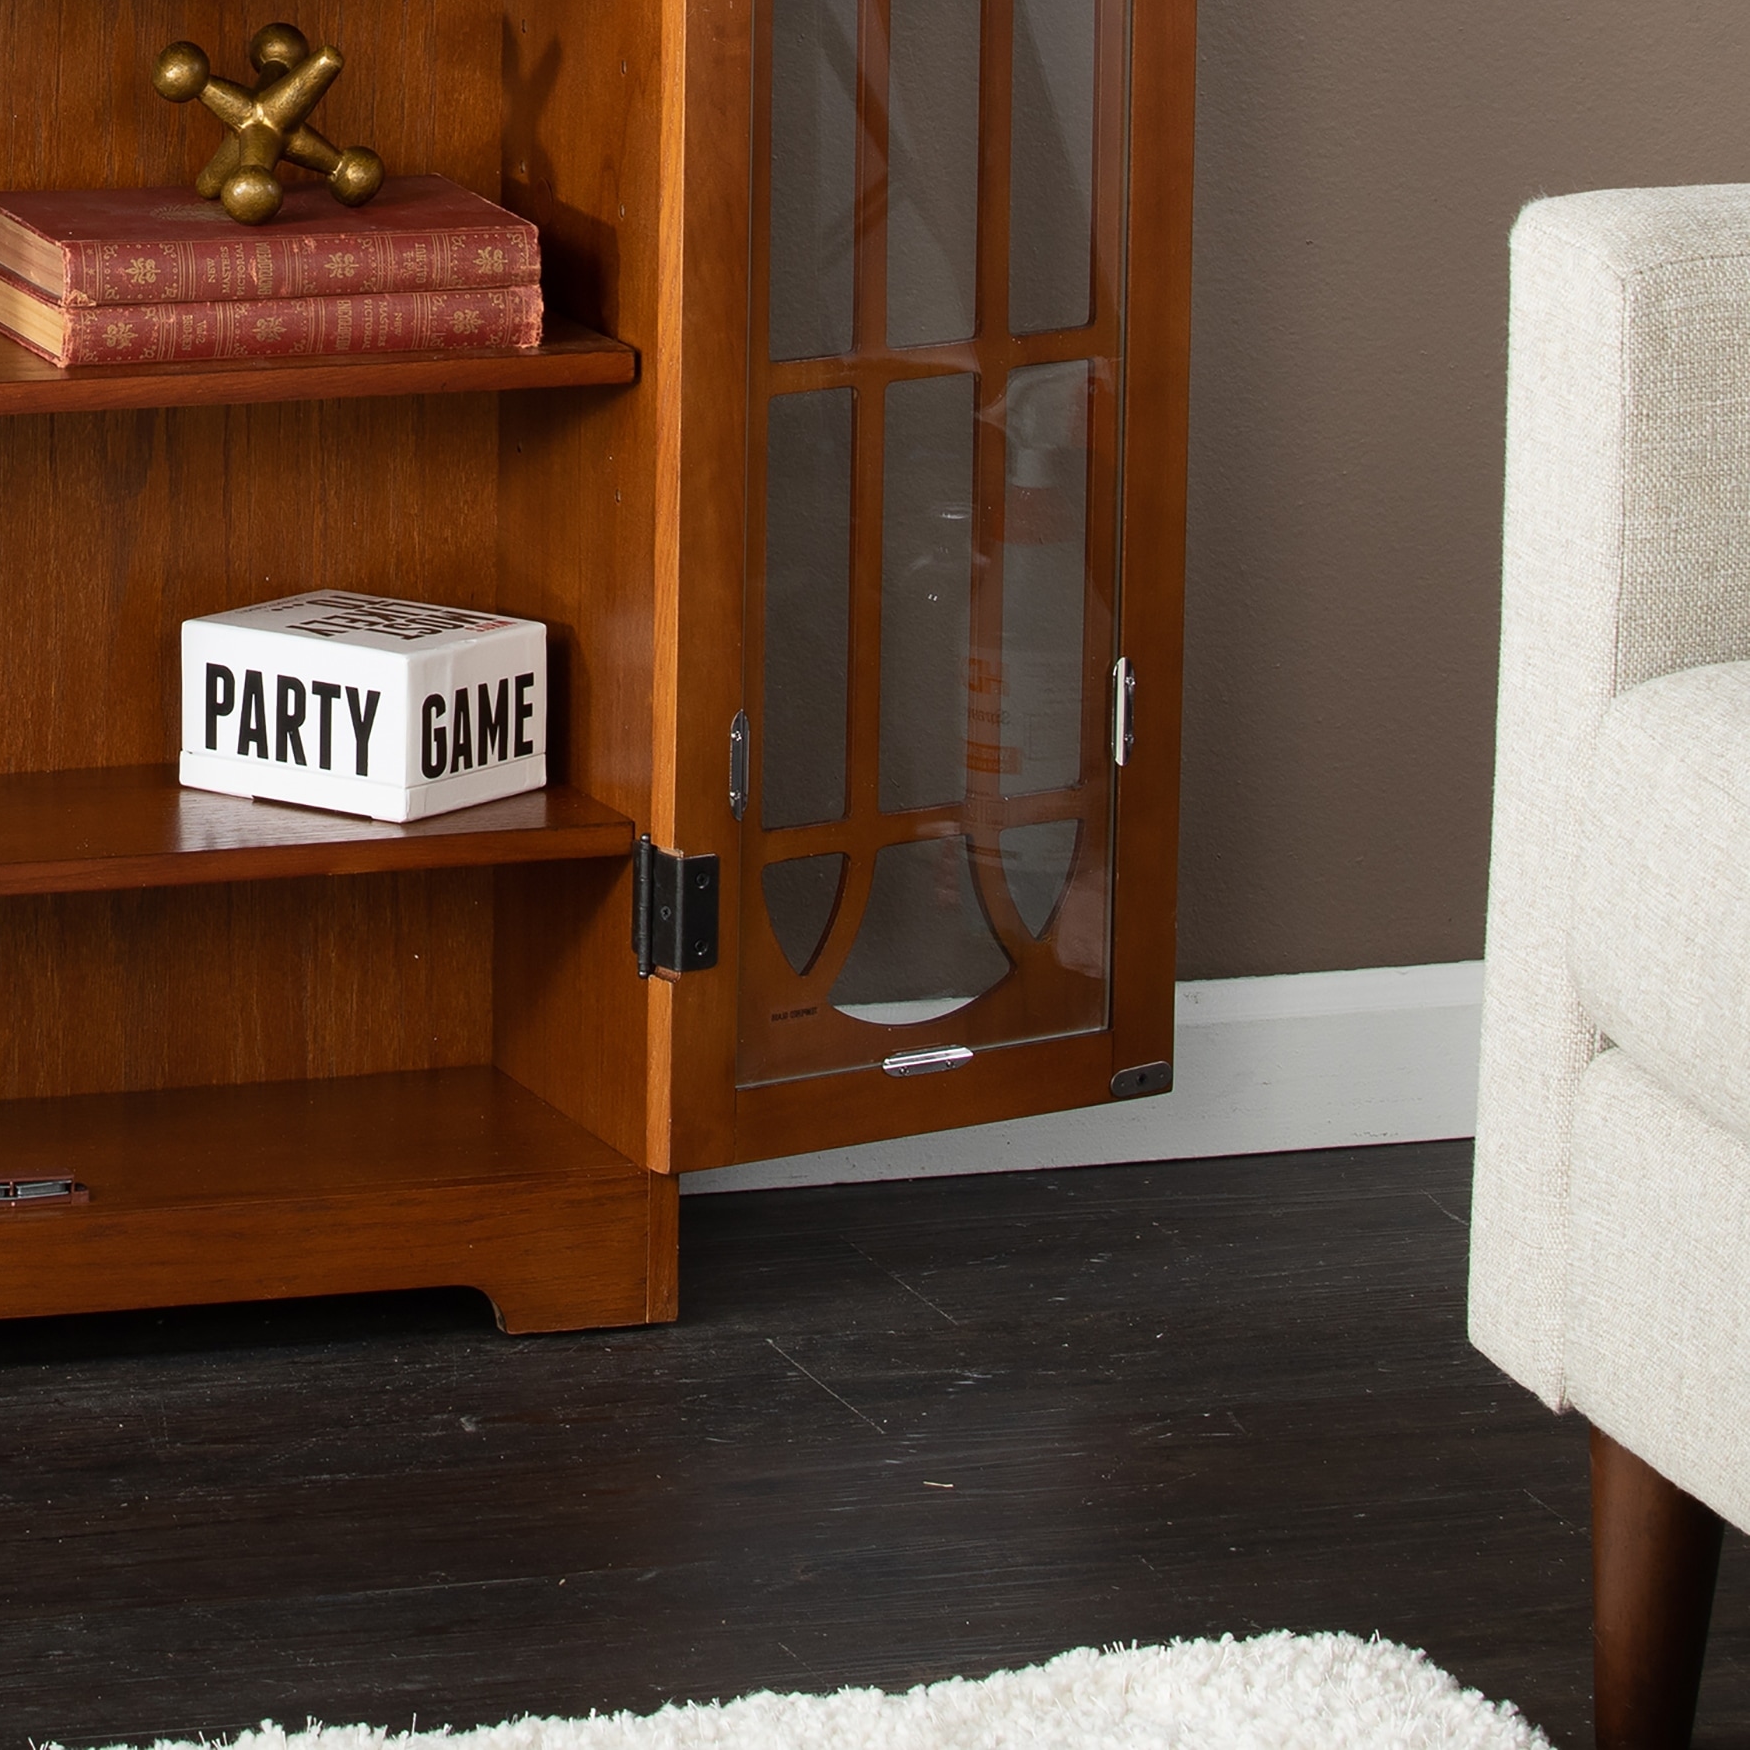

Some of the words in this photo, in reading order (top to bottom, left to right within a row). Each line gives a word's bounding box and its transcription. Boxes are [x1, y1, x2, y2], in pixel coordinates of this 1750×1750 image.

[207, 257, 217, 283] NEW
[220, 246, 232, 293] MASTERS
[235, 242, 246, 295] PICTORIAL
[362, 298, 373, 350] PICTORIAL
[378, 301, 389, 347] MASTERS
[393, 312, 403, 337] NEW
[286, 602, 442, 637] LIKELY
[364, 610, 496, 641] MOST
[204, 662, 382, 778] PARTY
[420, 671, 535, 780] GAME
